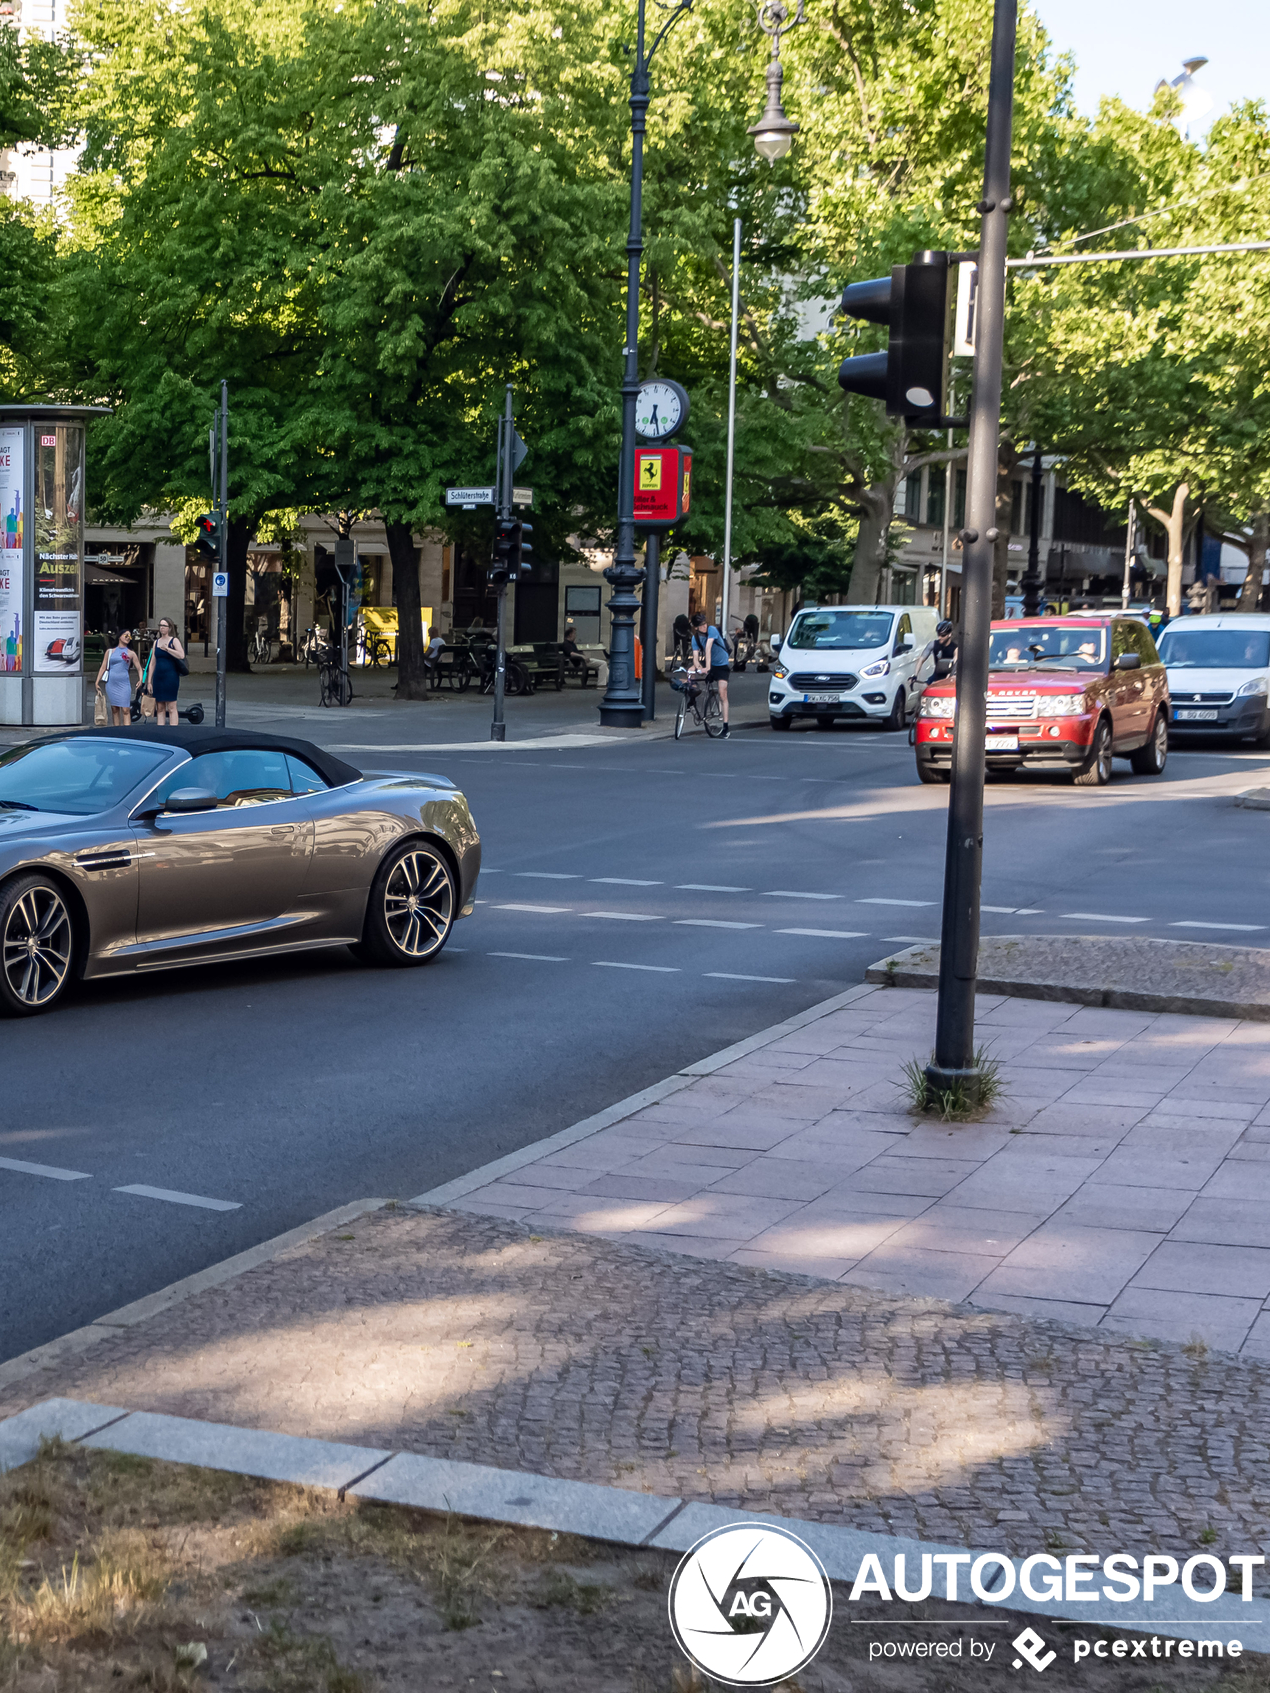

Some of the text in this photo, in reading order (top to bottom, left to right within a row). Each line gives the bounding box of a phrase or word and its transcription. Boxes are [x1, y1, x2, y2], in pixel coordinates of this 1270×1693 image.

[42, 437, 55, 445] DB
[451, 491, 489, 500] Schlüterstraße
[650, 495, 656, 503] &
